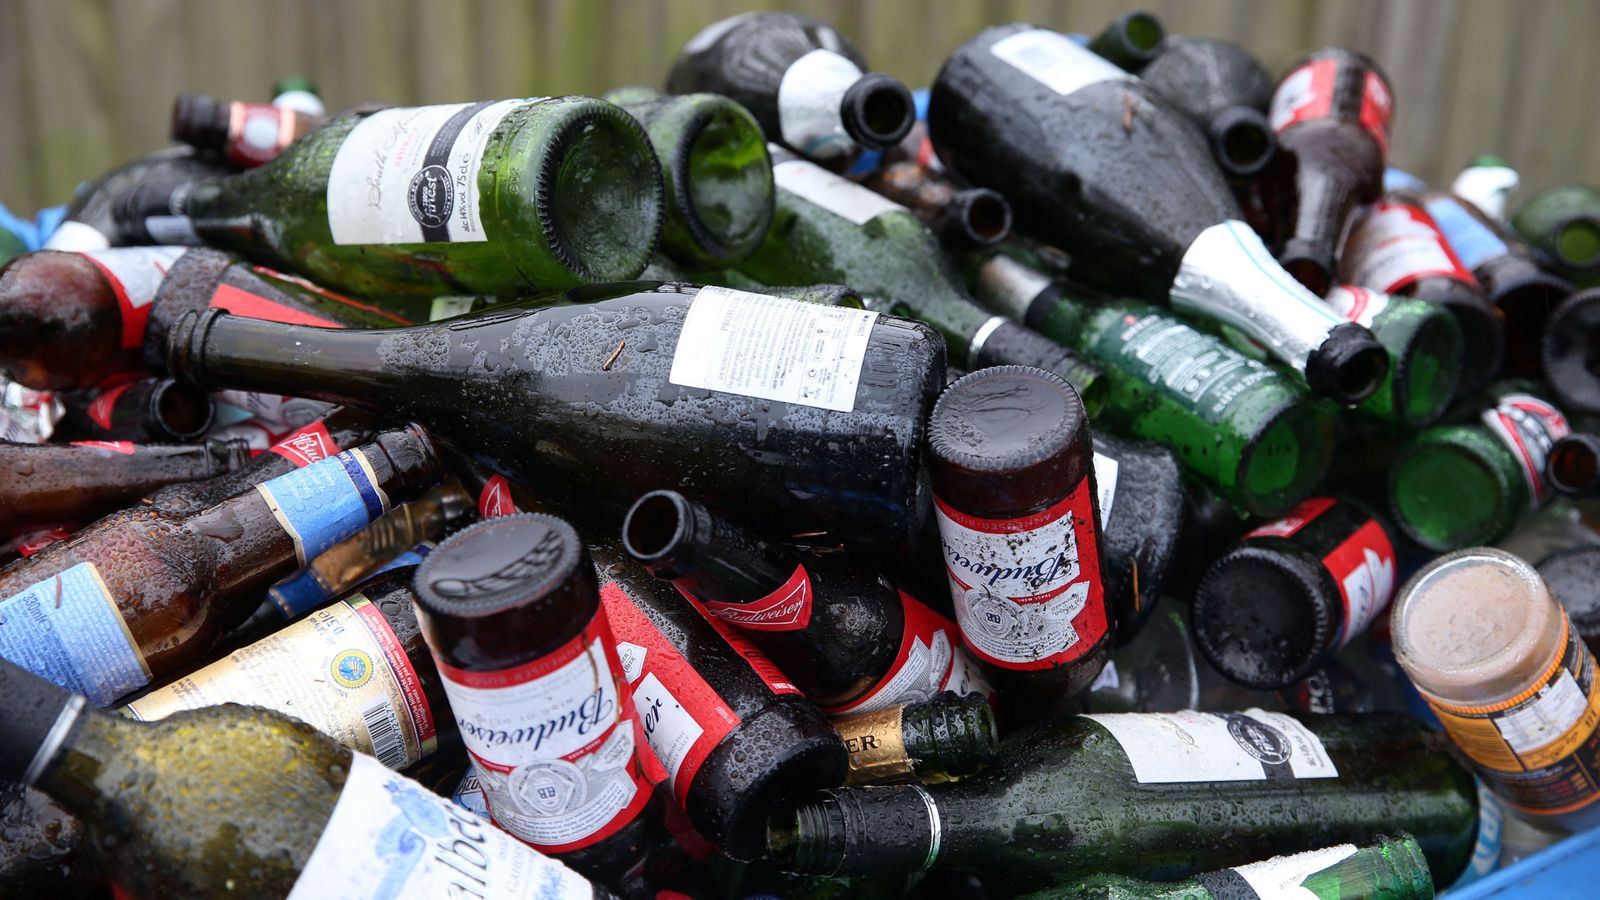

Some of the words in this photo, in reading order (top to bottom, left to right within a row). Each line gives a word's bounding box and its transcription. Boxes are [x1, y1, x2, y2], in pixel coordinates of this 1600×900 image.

[423, 176, 441, 222] finest
[718, 601, 802, 620] Budweiser
[459, 686, 613, 750] Budweiser
